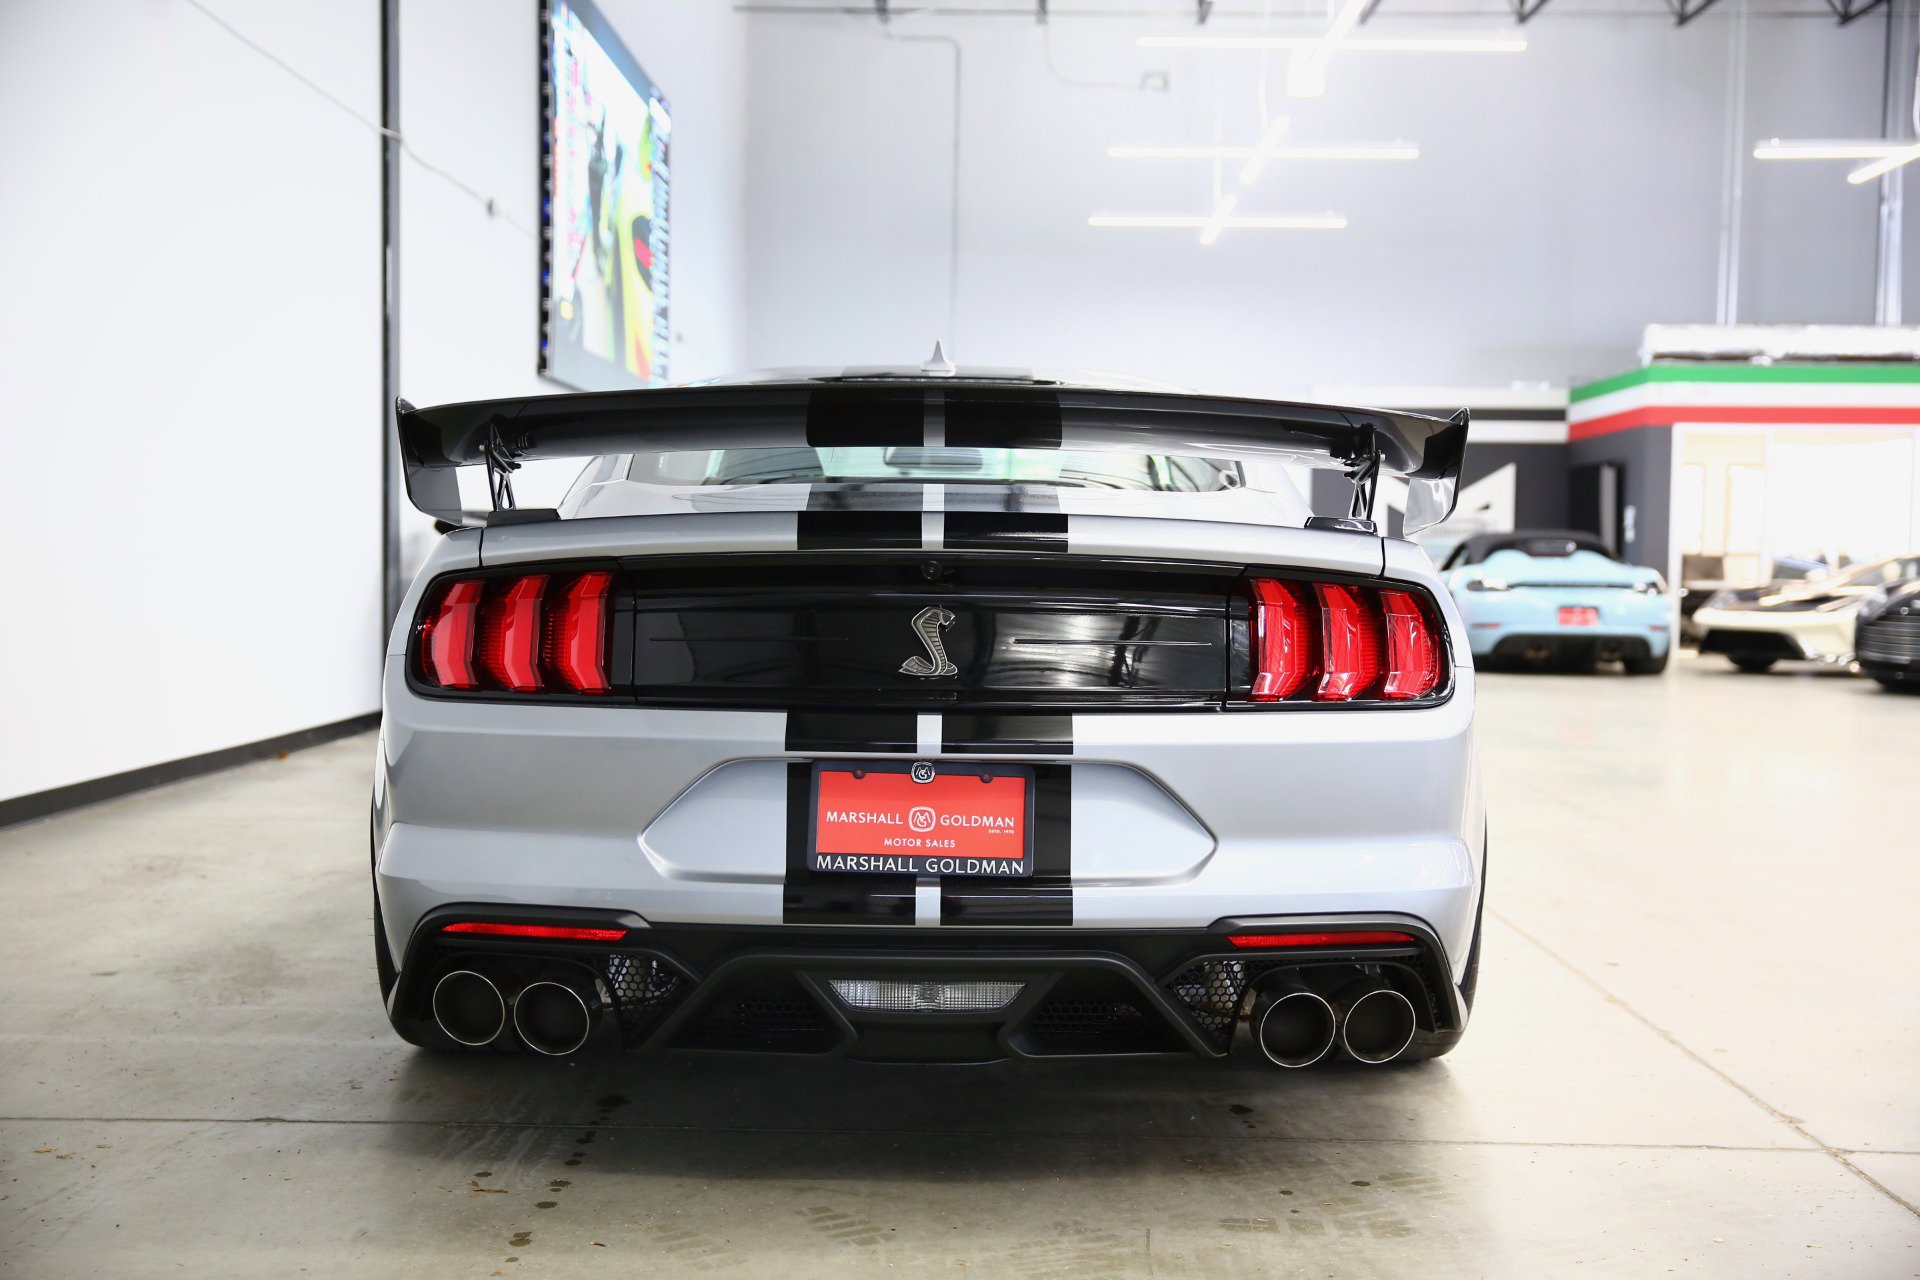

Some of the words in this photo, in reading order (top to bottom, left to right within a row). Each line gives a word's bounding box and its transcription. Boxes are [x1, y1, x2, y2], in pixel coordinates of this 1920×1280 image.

[826, 811, 903, 824] MARSHALL
[940, 815, 1014, 827] GOLDMAN
[884, 838, 921, 847] MOTOR
[925, 839, 956, 848] SALES
[816, 855, 919, 871] MARSHALL
[925, 858, 1024, 875] GOLDMAN
